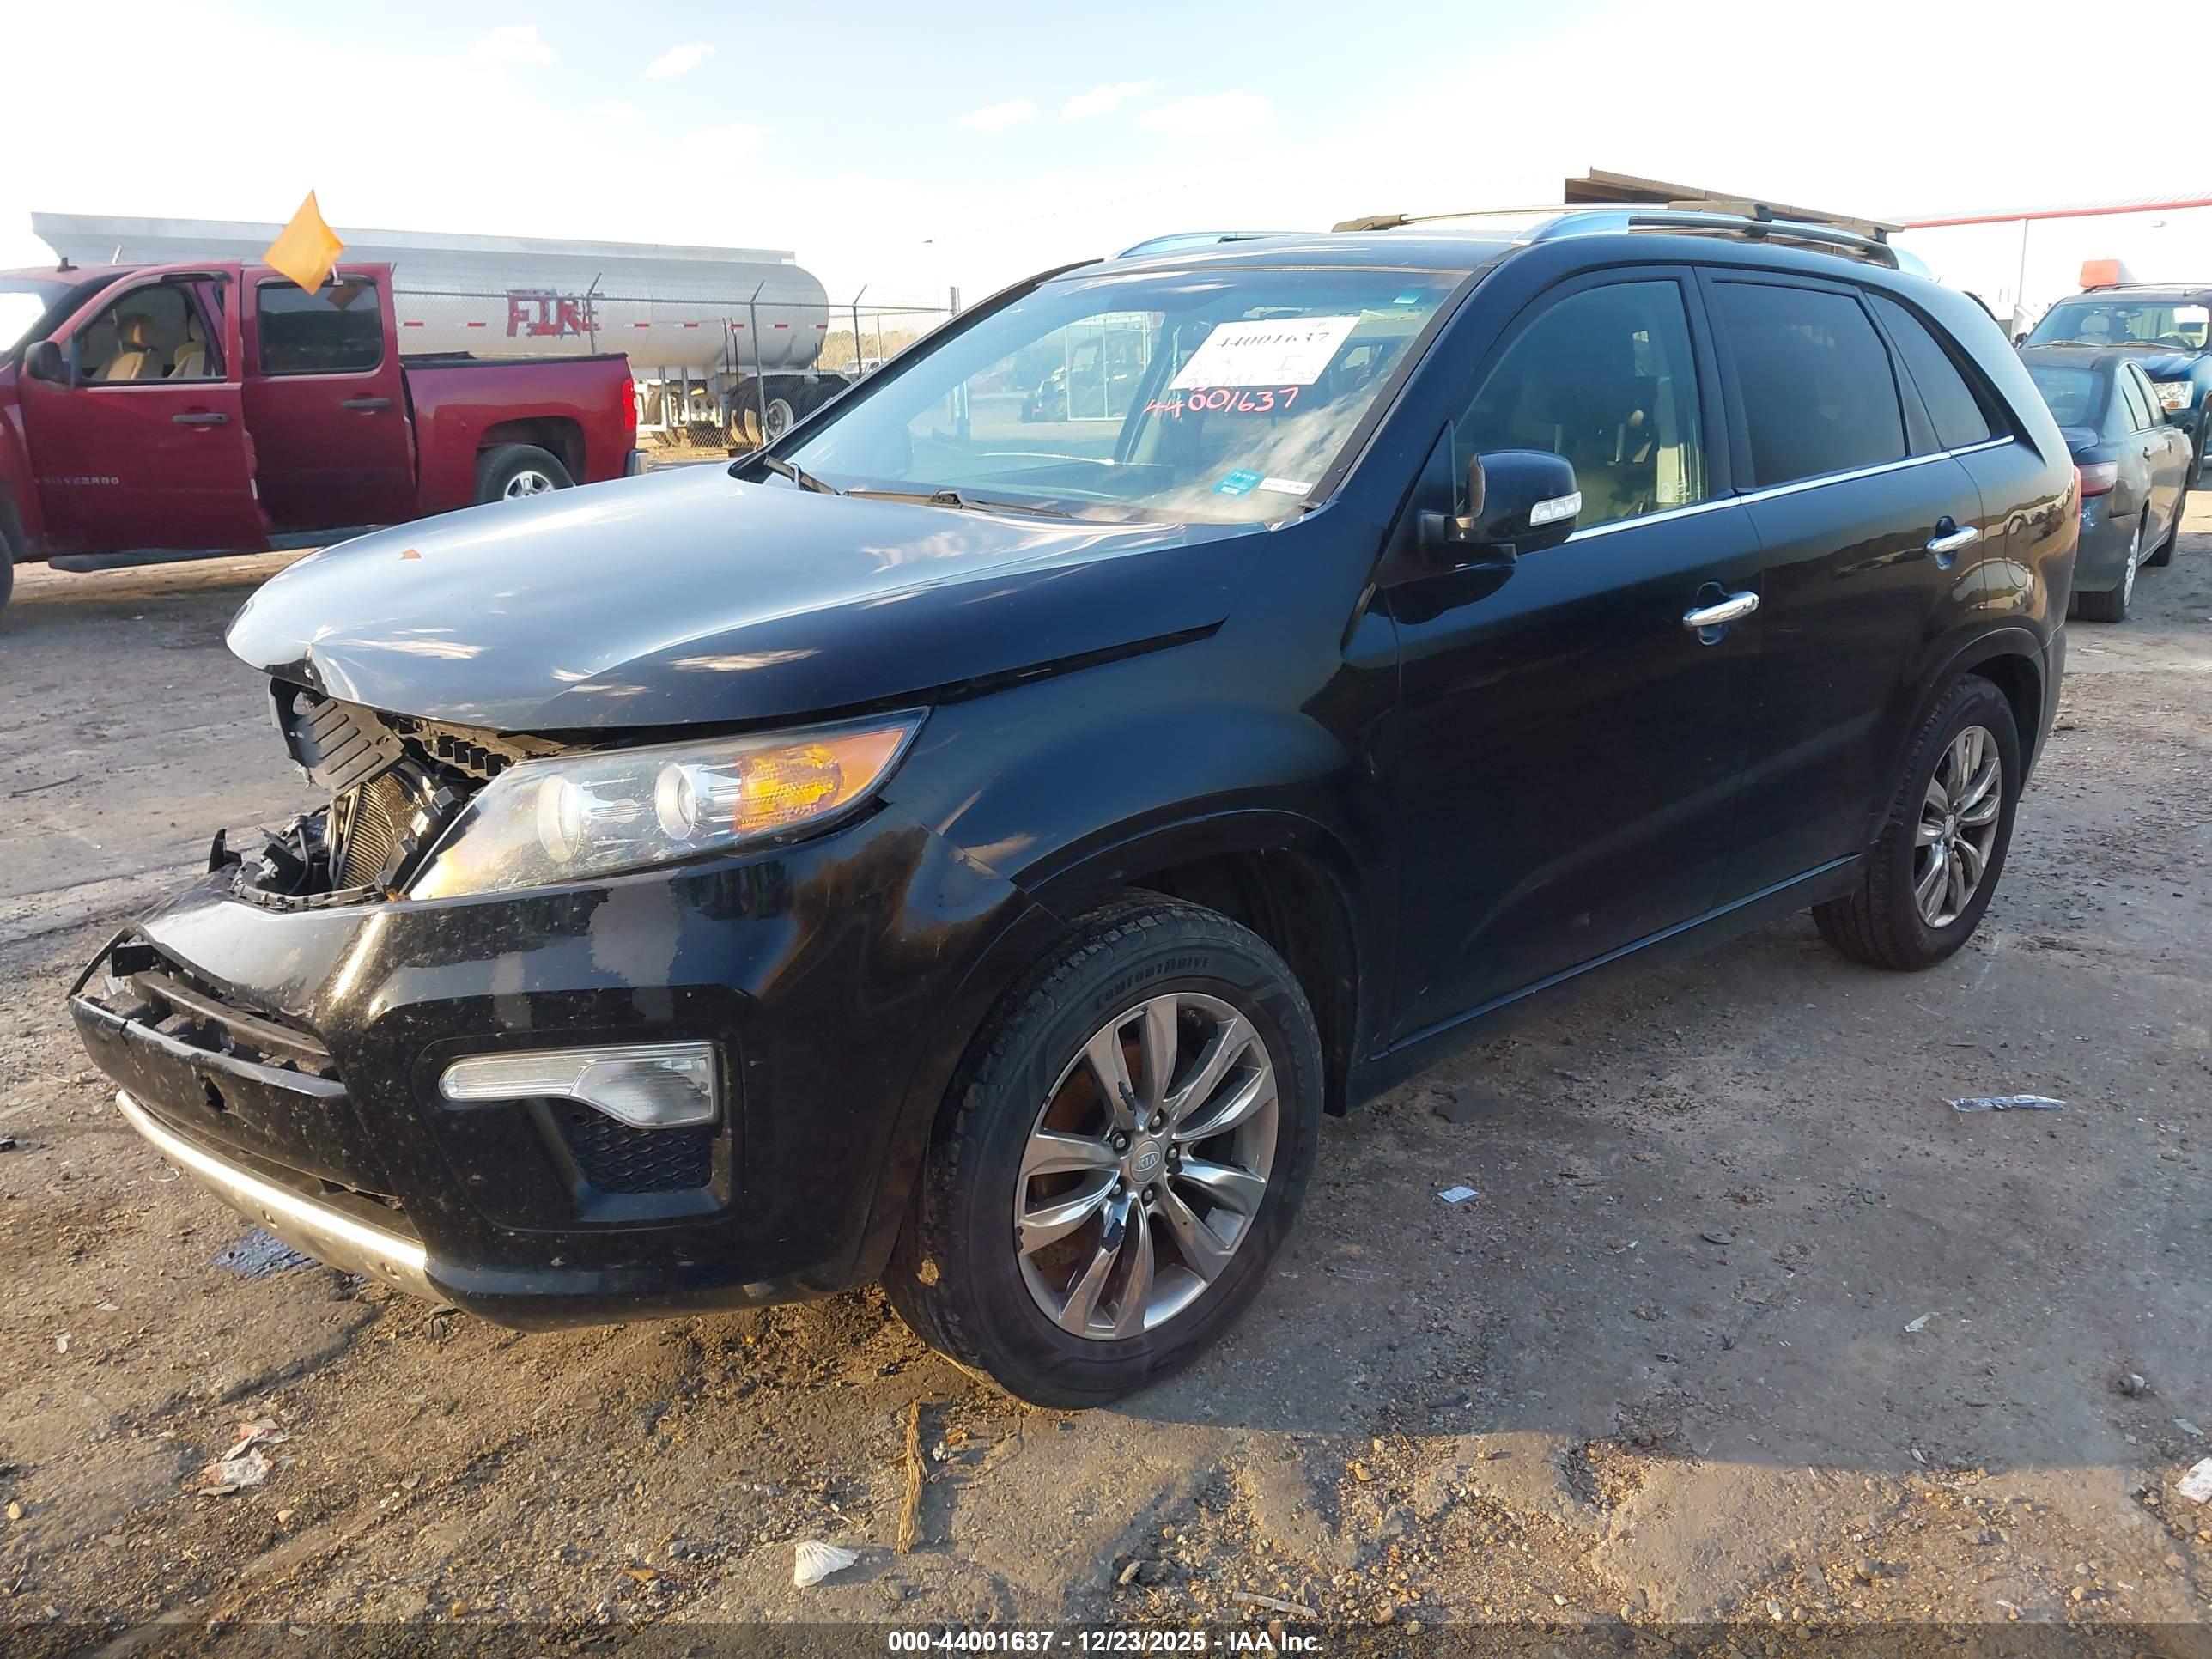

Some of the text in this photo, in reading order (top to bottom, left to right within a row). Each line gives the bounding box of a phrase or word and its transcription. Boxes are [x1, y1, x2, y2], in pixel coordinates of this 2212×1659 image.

[507, 288, 602, 338] FIRE
[1143, 386, 1299, 419] 44001637
[41, 477, 119, 485] SILVERADO
[1139, 1154, 1157, 1169] KIA
